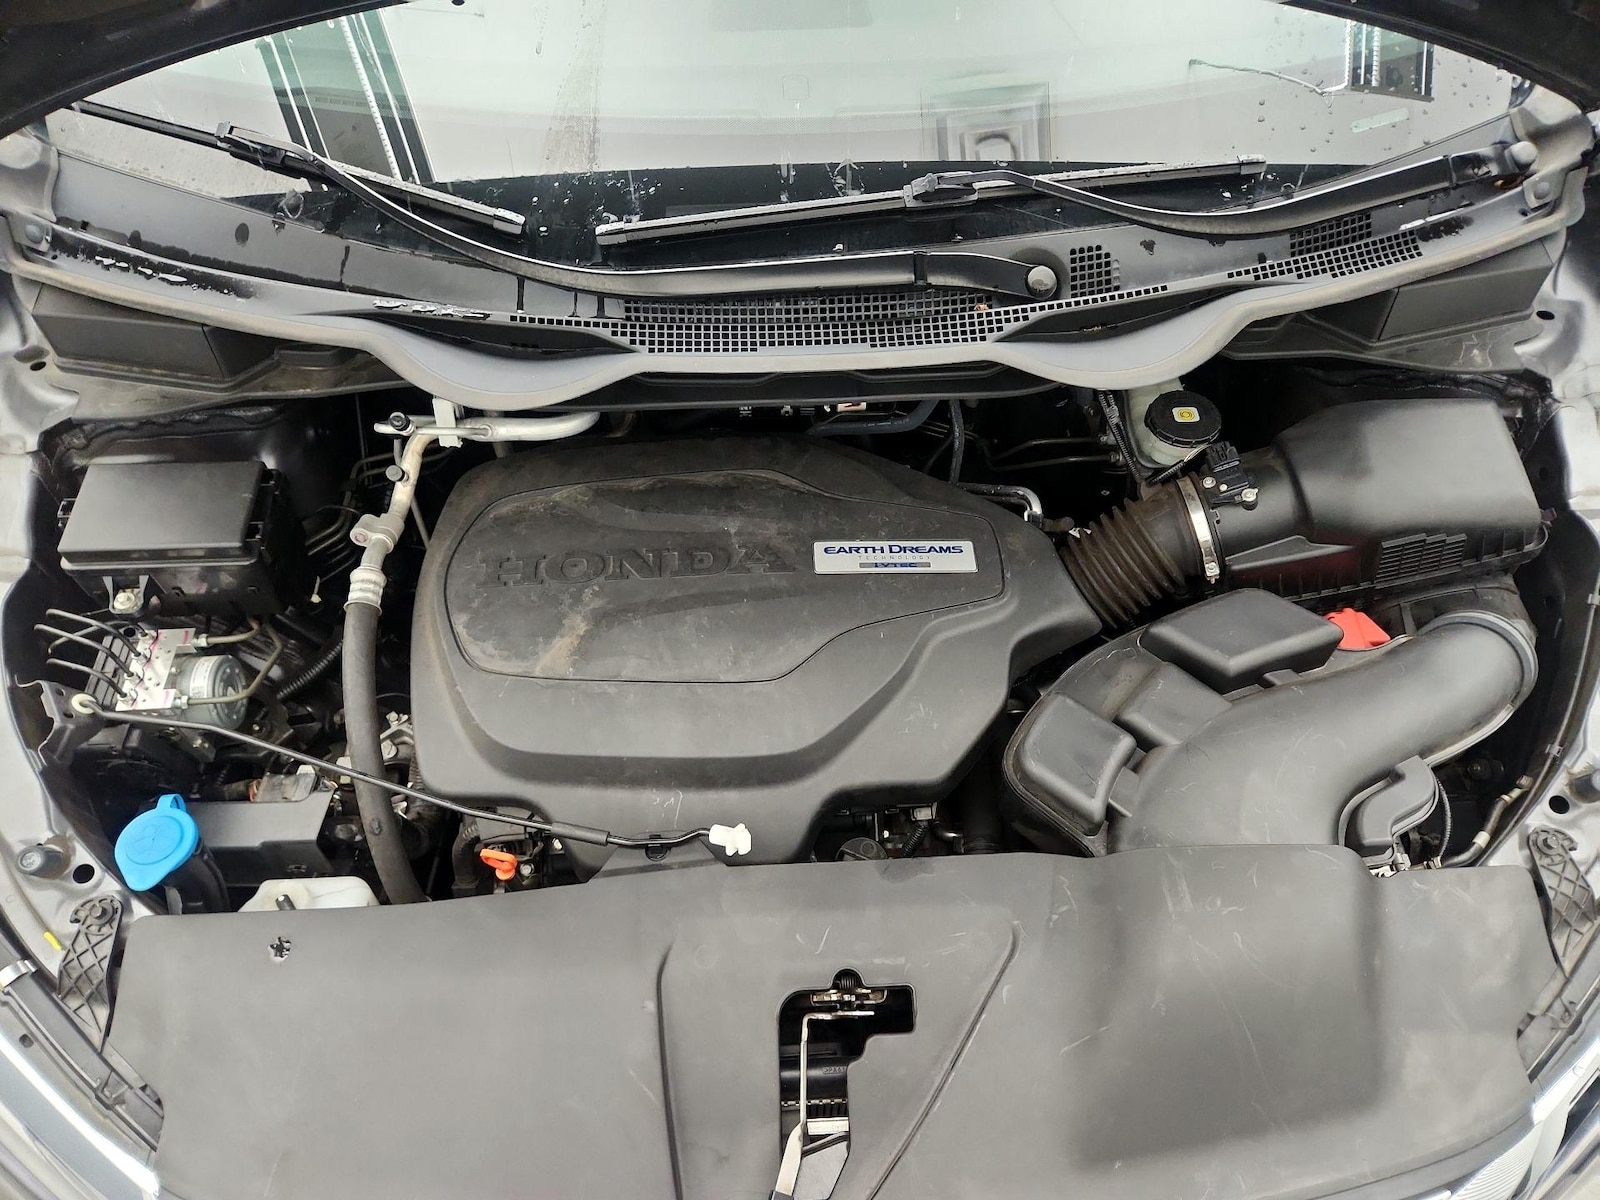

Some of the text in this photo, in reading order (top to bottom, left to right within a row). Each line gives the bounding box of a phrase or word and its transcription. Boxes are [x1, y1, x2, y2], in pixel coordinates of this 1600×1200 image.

[824, 544, 964, 555] EARTH DREAMS
[476, 547, 796, 590] HONDA
